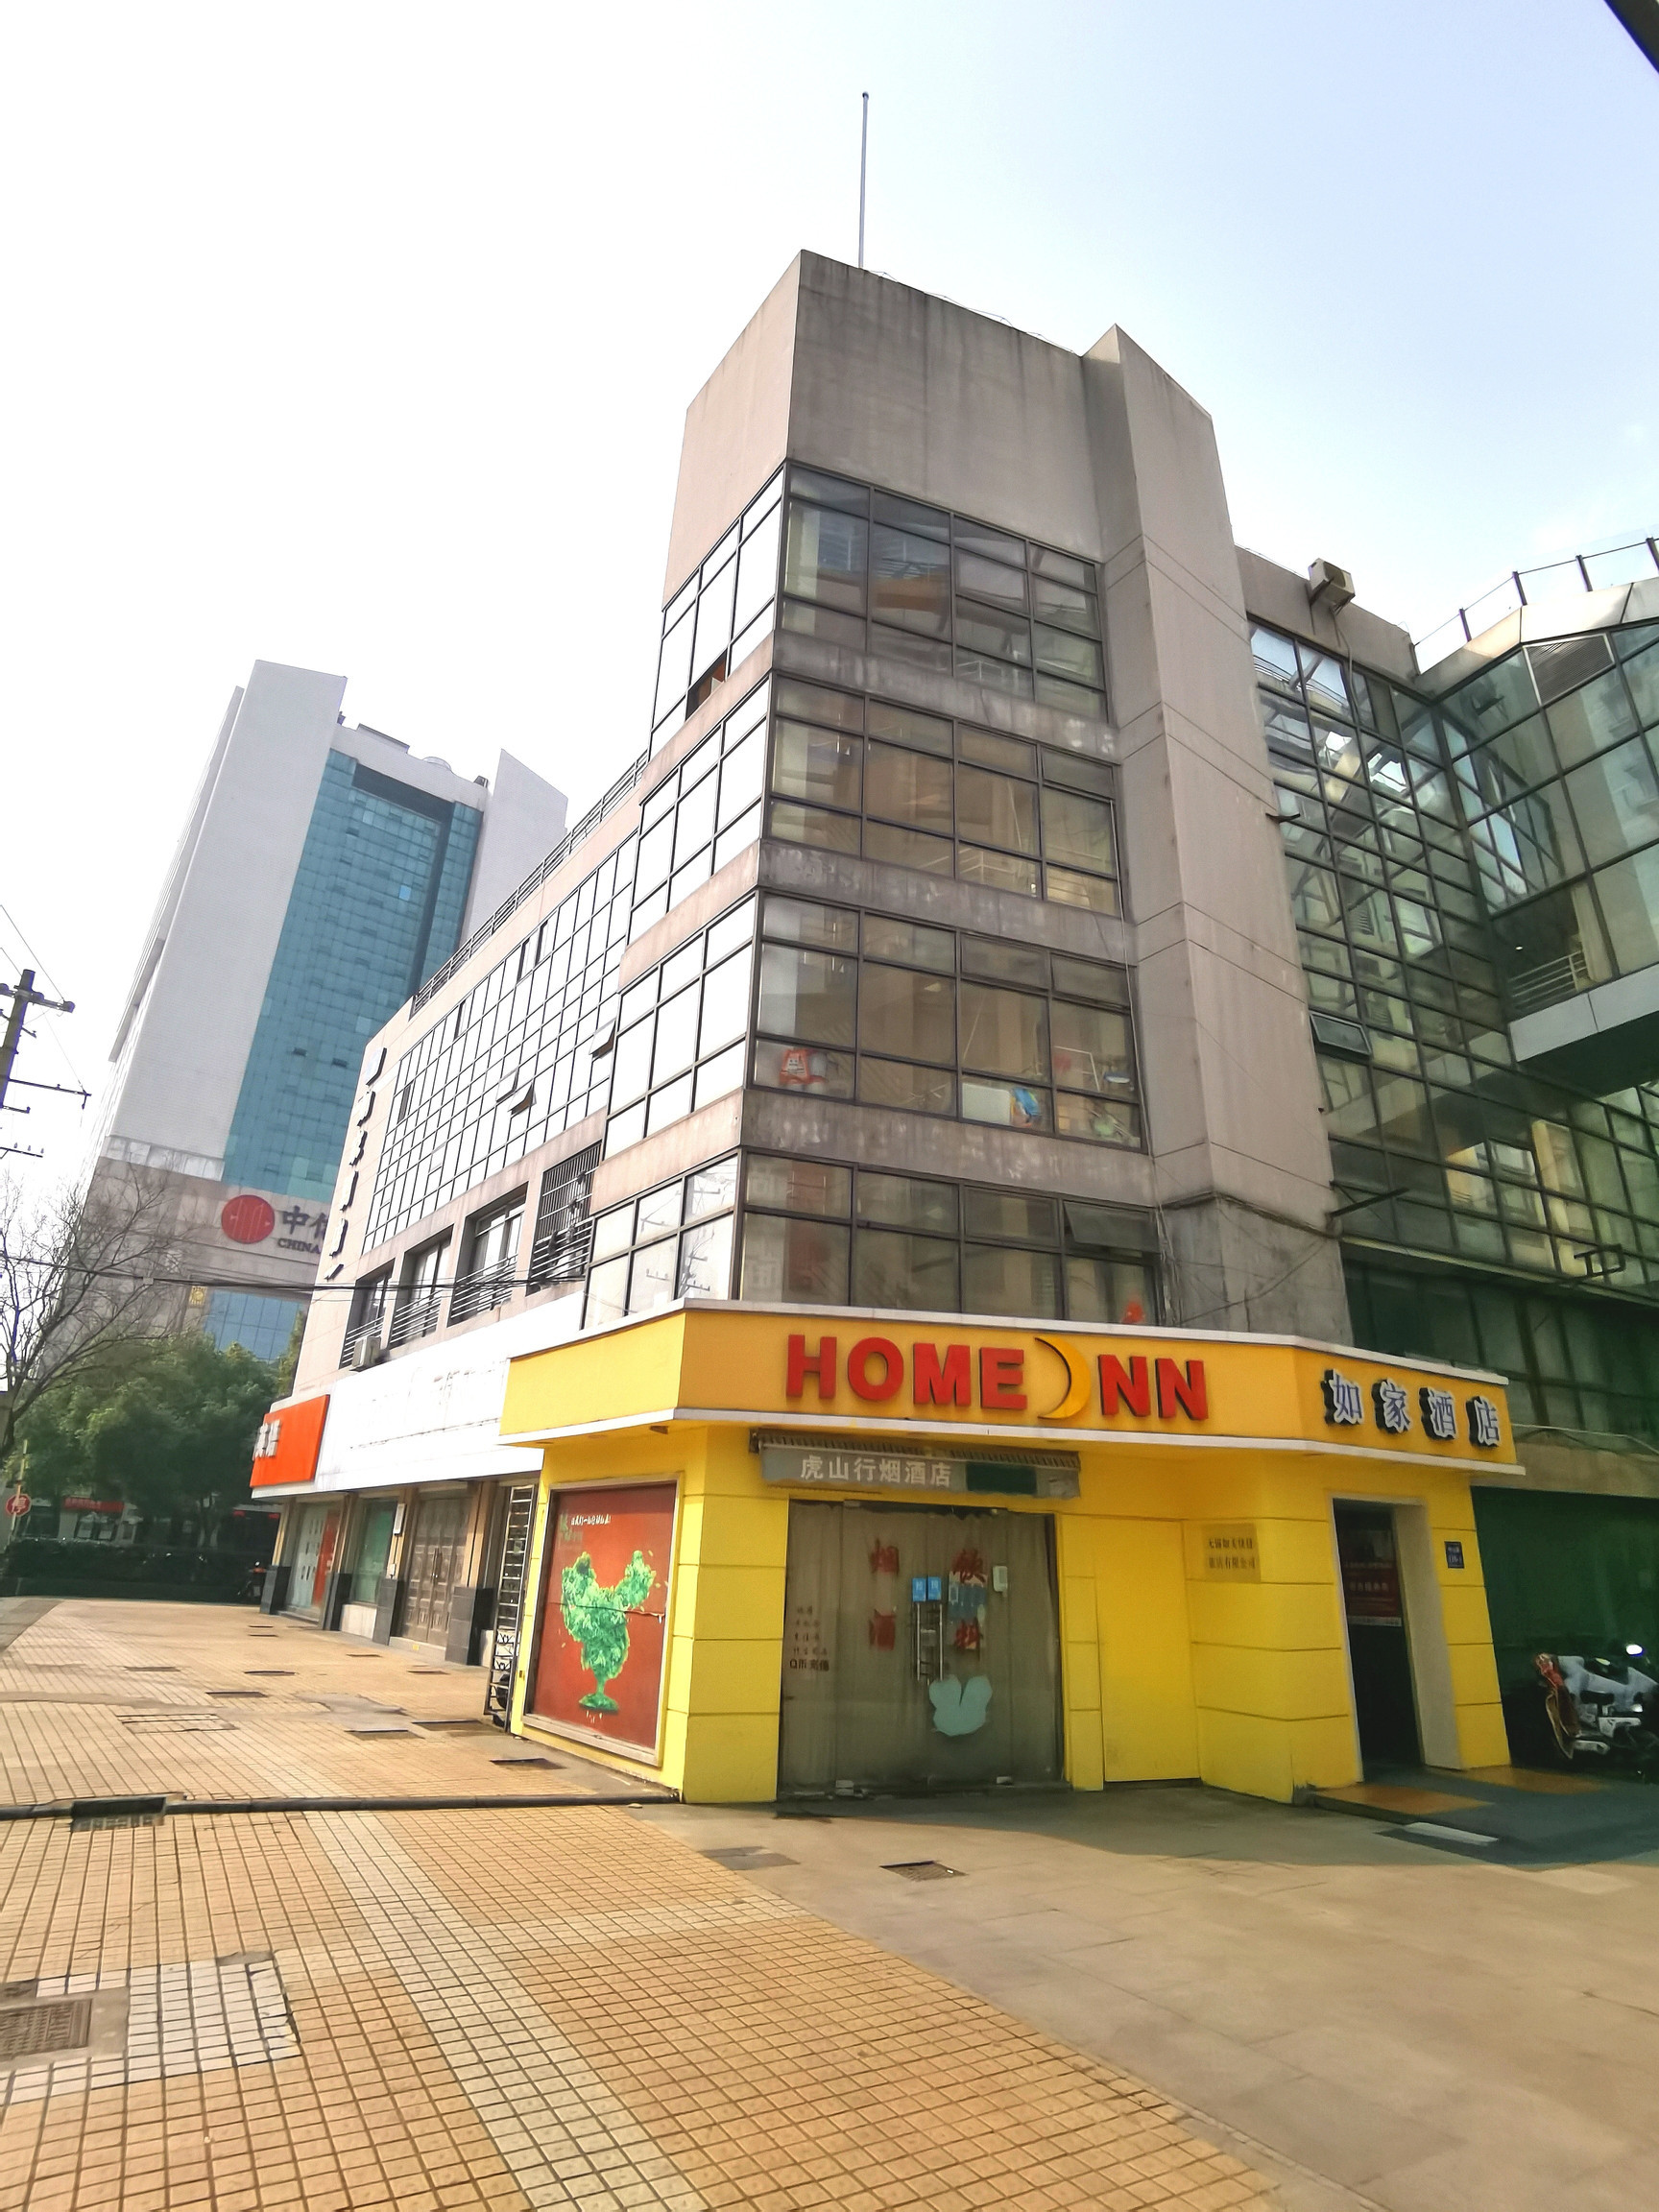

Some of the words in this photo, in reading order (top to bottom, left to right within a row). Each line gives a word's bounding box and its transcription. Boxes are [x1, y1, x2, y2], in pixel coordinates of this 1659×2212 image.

[277, 1238, 322, 1255] CHINA
[785, 1334, 1028, 1411] HOME
[1322, 1369, 1500, 1447] 如家酒店
[800, 1455, 952, 1488] 虎山行烟酒店
